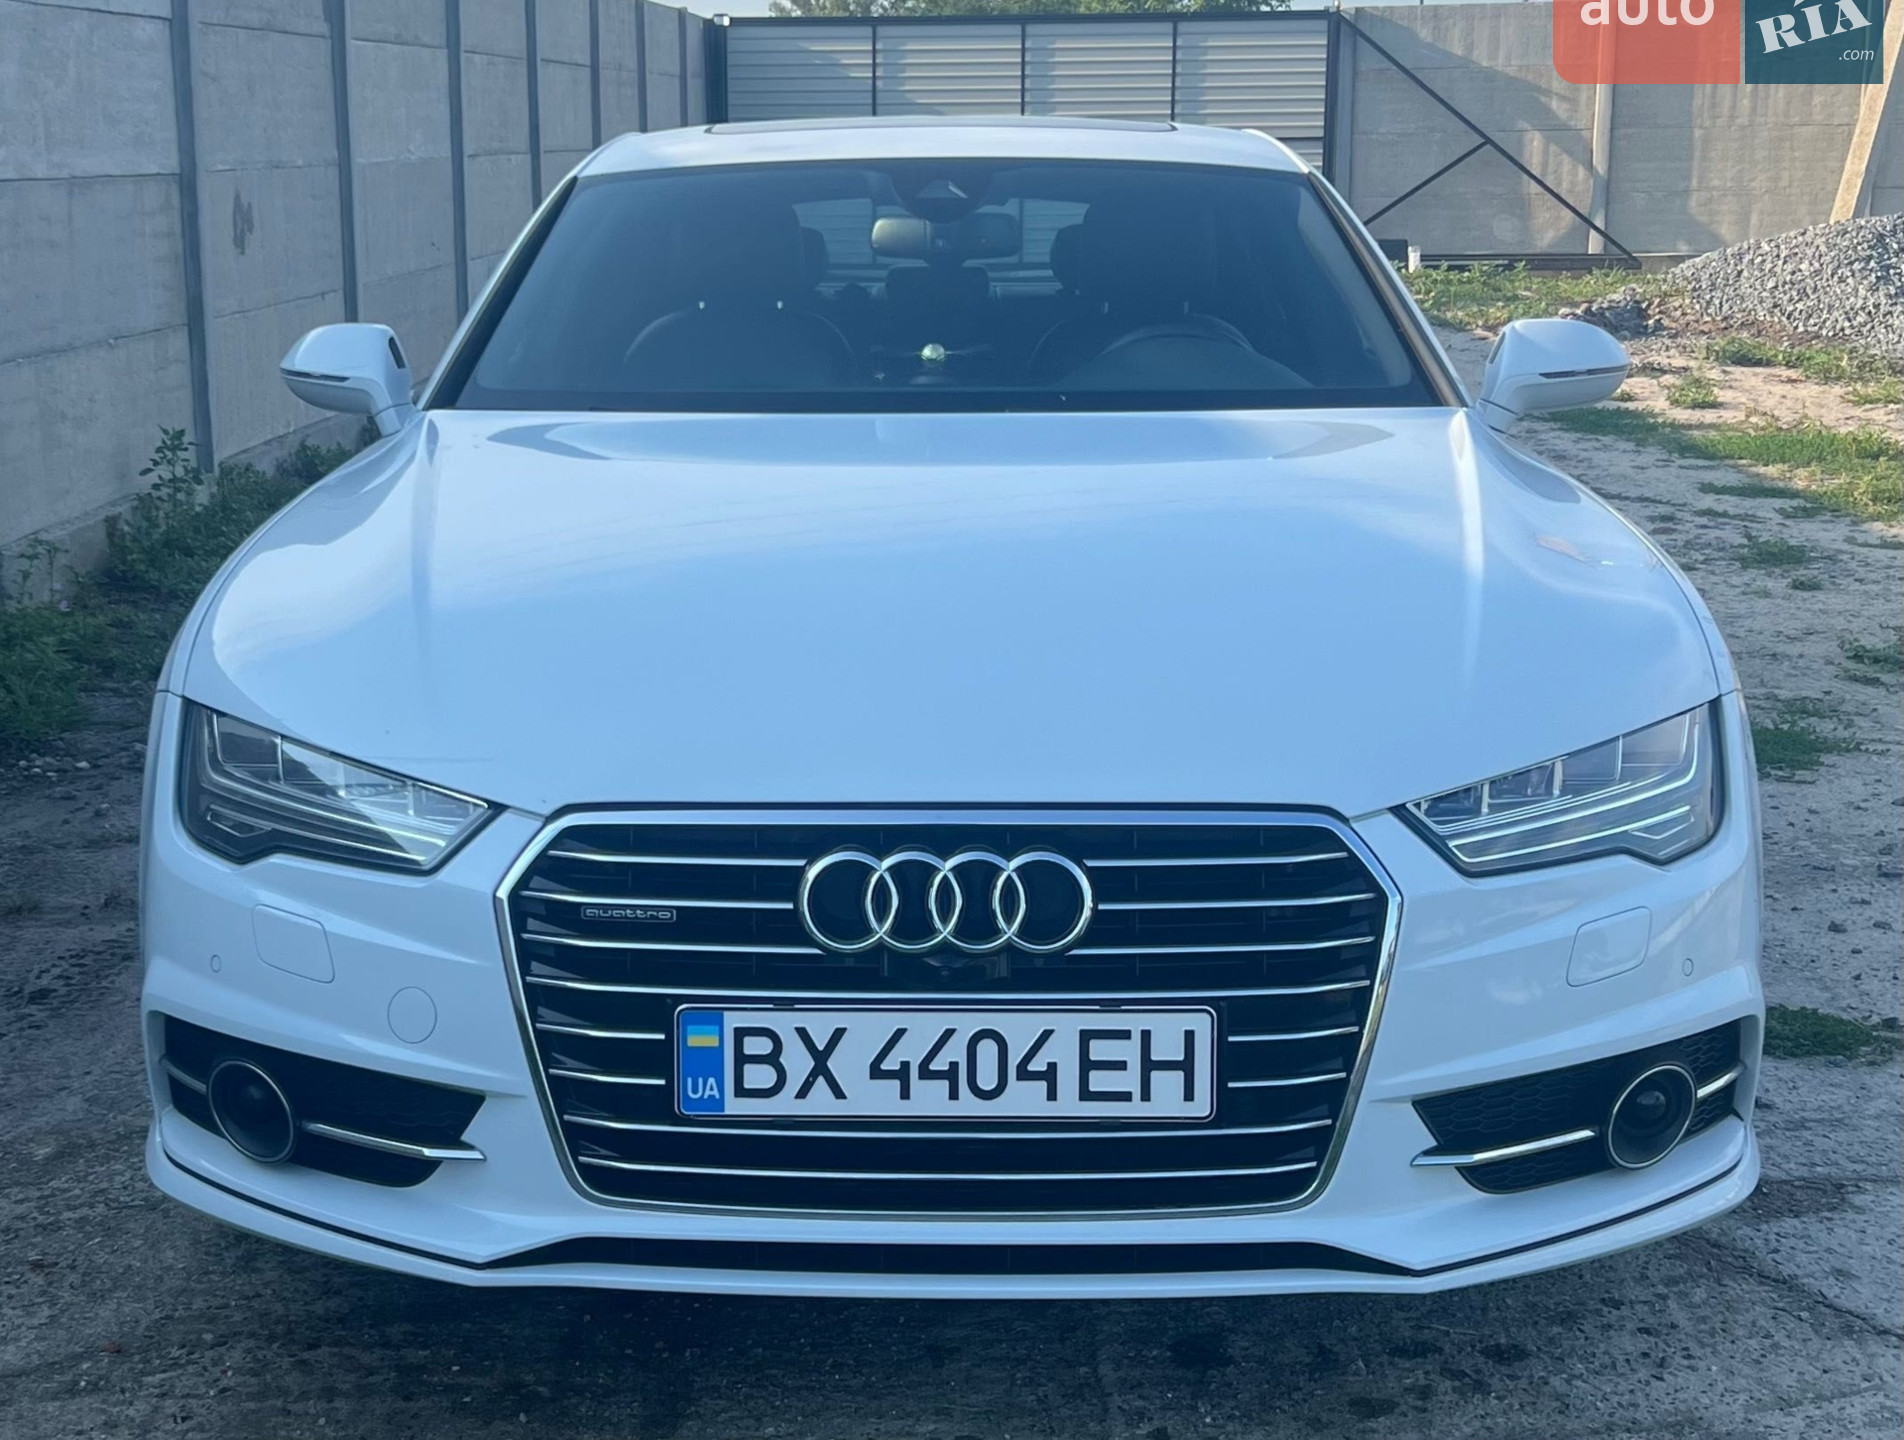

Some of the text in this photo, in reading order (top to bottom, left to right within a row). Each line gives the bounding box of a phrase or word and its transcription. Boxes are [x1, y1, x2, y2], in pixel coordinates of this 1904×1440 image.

[585, 908, 672, 919] quattro
[732, 1026, 1196, 1102] BX 4404 EH
[687, 1077, 720, 1099] UA
